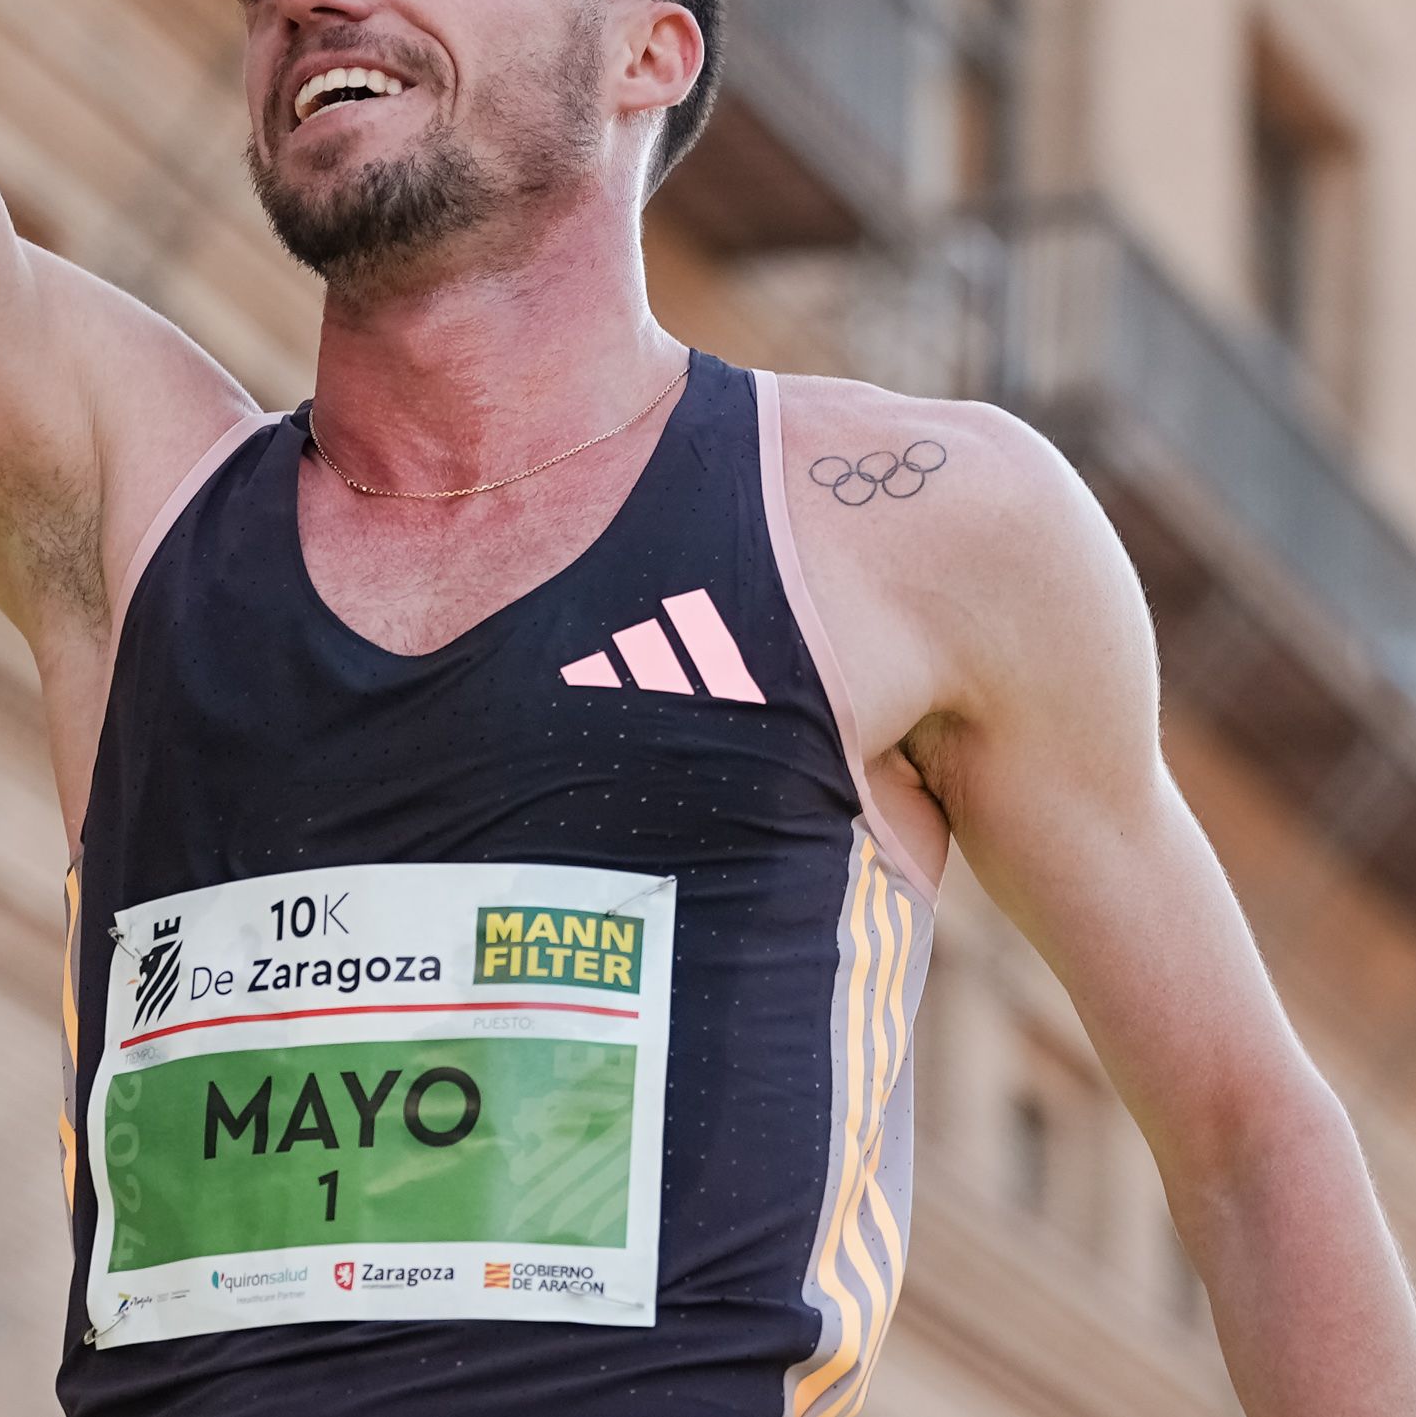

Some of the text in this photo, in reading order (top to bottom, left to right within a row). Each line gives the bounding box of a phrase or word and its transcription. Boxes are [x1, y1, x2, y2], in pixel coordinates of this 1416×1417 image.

[270, 892, 350, 941] 10K
[485, 912, 635, 953] MANN
[190, 955, 441, 1001] De Zaragoza
[483, 946, 633, 987] FILTER
[203, 1066, 482, 1160] MAYO
[318, 1170, 339, 1221] 1
[361, 1264, 455, 1287] Zaragoza
[512, 1278, 532, 1291] DE
[513, 1263, 594, 1280] GOBIERNO
